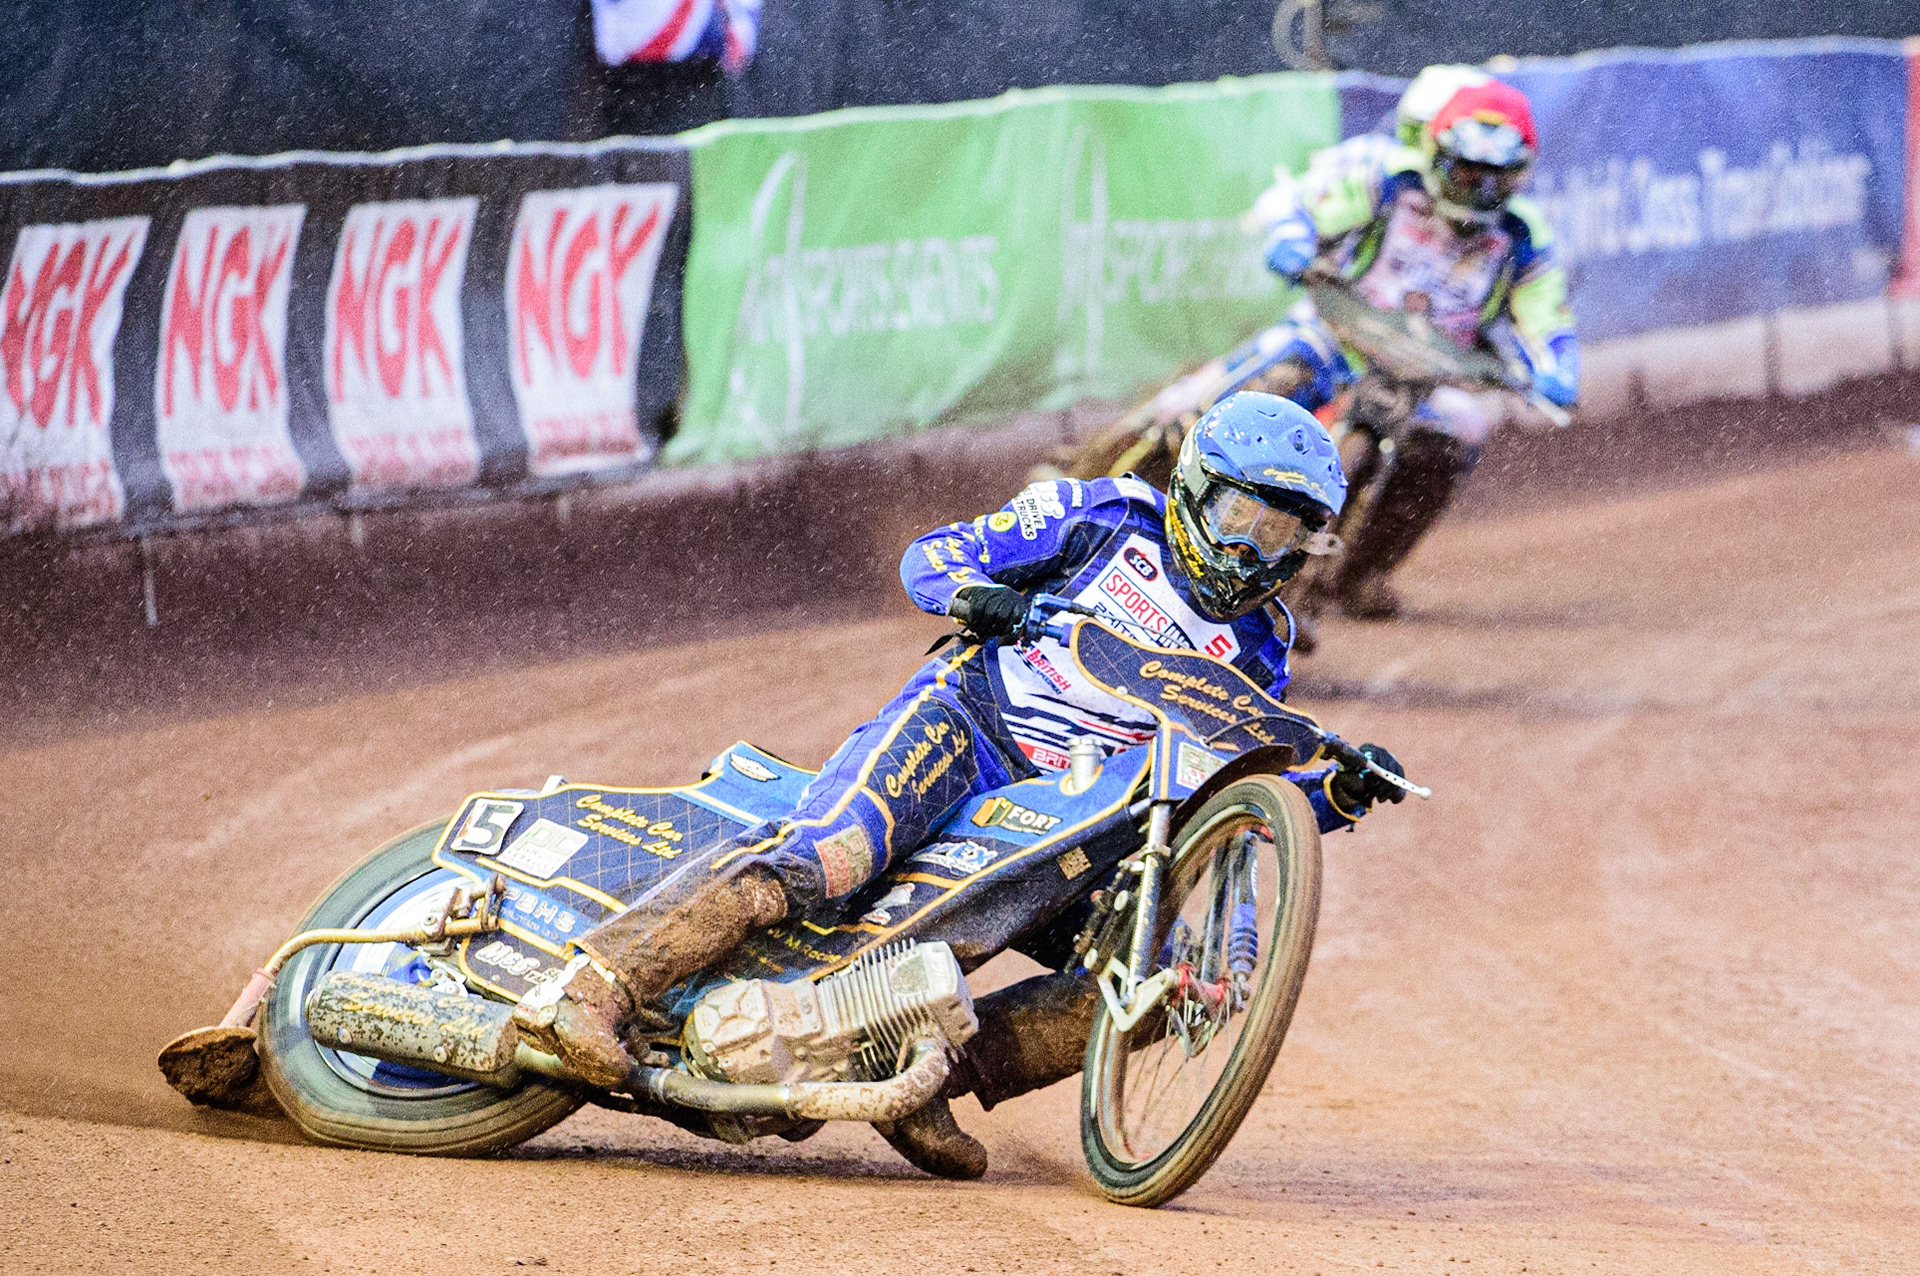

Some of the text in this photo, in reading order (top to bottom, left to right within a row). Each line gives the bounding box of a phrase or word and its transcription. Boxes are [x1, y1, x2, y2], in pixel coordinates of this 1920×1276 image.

[331, 216, 465, 404] NGK
[515, 200, 662, 388] NGK
[2, 232, 134, 428] NGK
[164, 222, 289, 418] NGK
[1015, 500, 1035, 538] TRUCKS
[1026, 498, 1043, 527] DRIVE
[1130, 554, 1154, 577] SCB
[1204, 634, 1232, 658] 5
[1026, 652, 1072, 690] BRITISH
[1139, 660, 1230, 701] Complete
[1160, 683, 1238, 725] Services
[885, 740, 933, 798] Complete
[911, 751, 955, 803] Services
[460, 804, 515, 849] 5
[575, 794, 684, 843] Complete Car
[576, 813, 684, 860] Services Ltd
[1006, 806, 1062, 831] FORT
[341, 992, 435, 1027] Services
